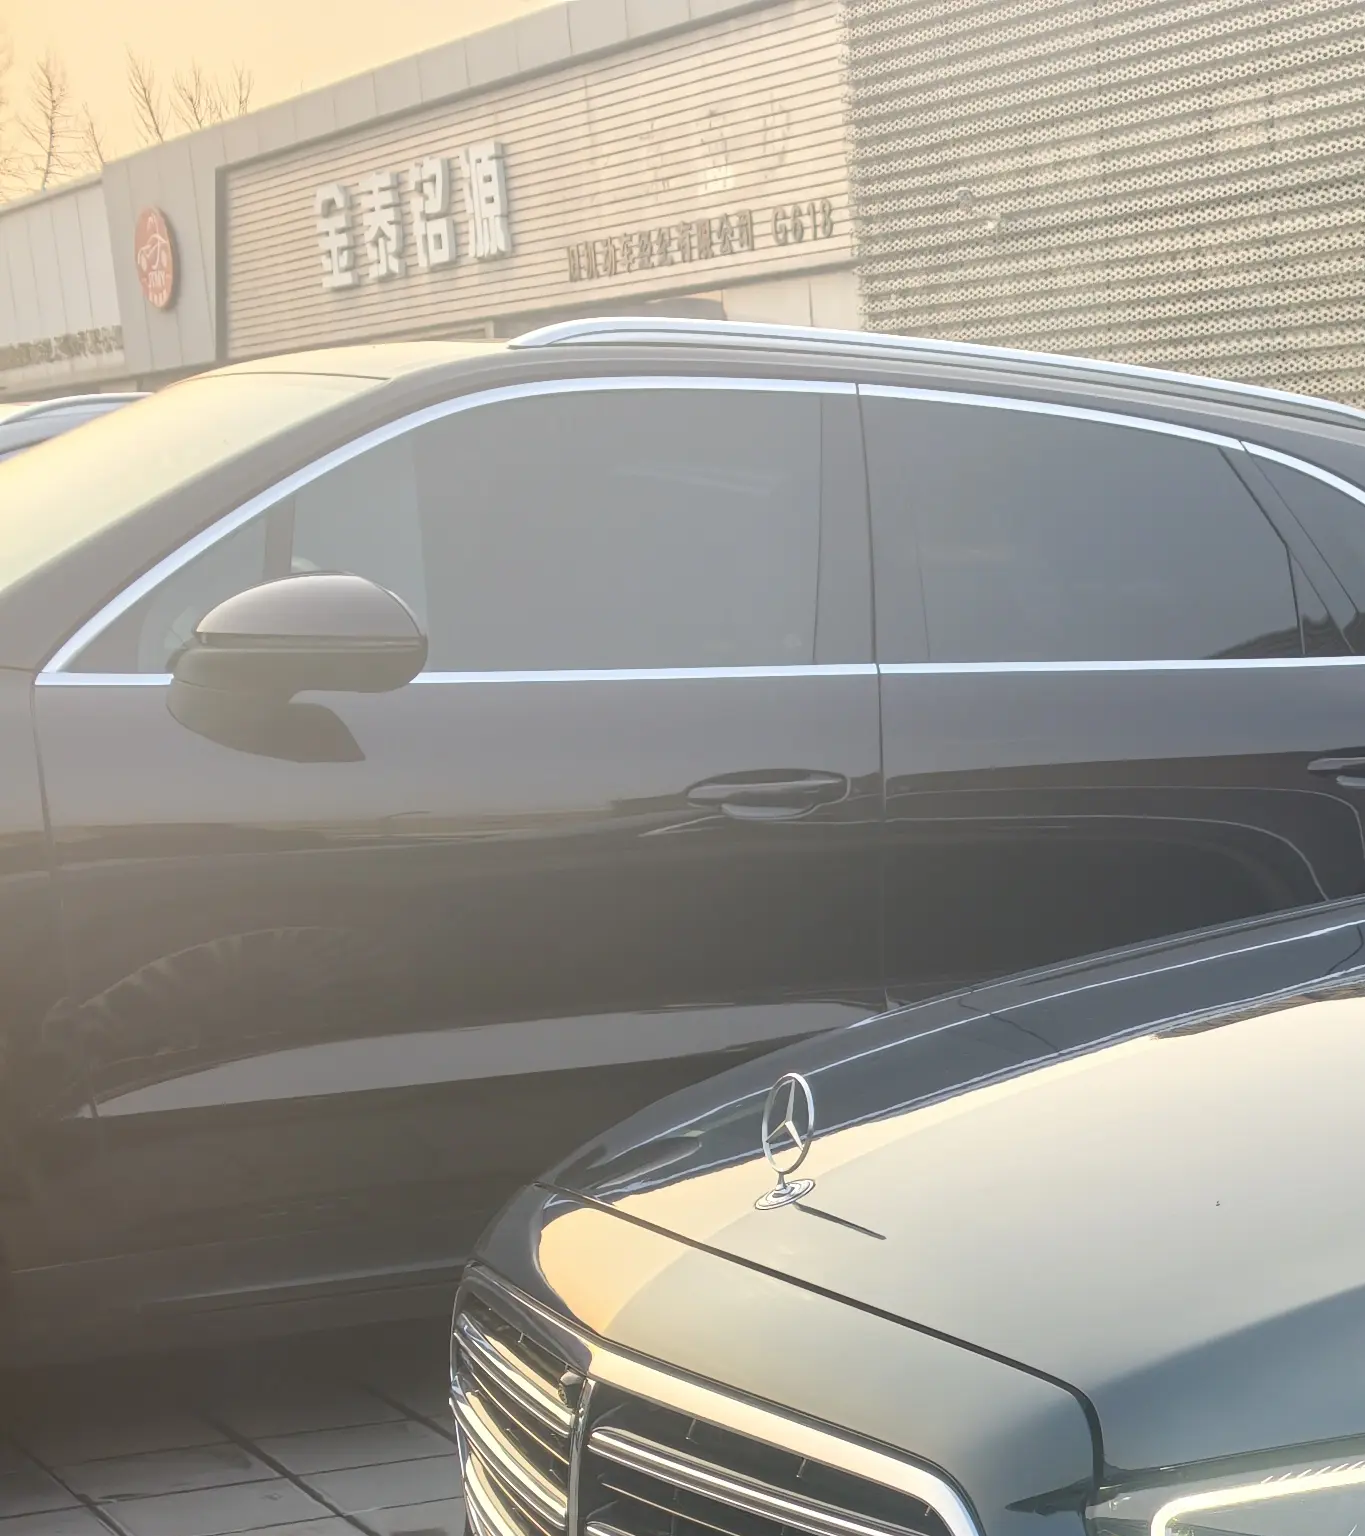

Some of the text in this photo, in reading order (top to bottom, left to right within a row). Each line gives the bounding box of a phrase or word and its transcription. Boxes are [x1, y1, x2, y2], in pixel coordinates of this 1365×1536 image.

[314, 141, 512, 290] 金泰铭源
[771, 199, 834, 246] G618
